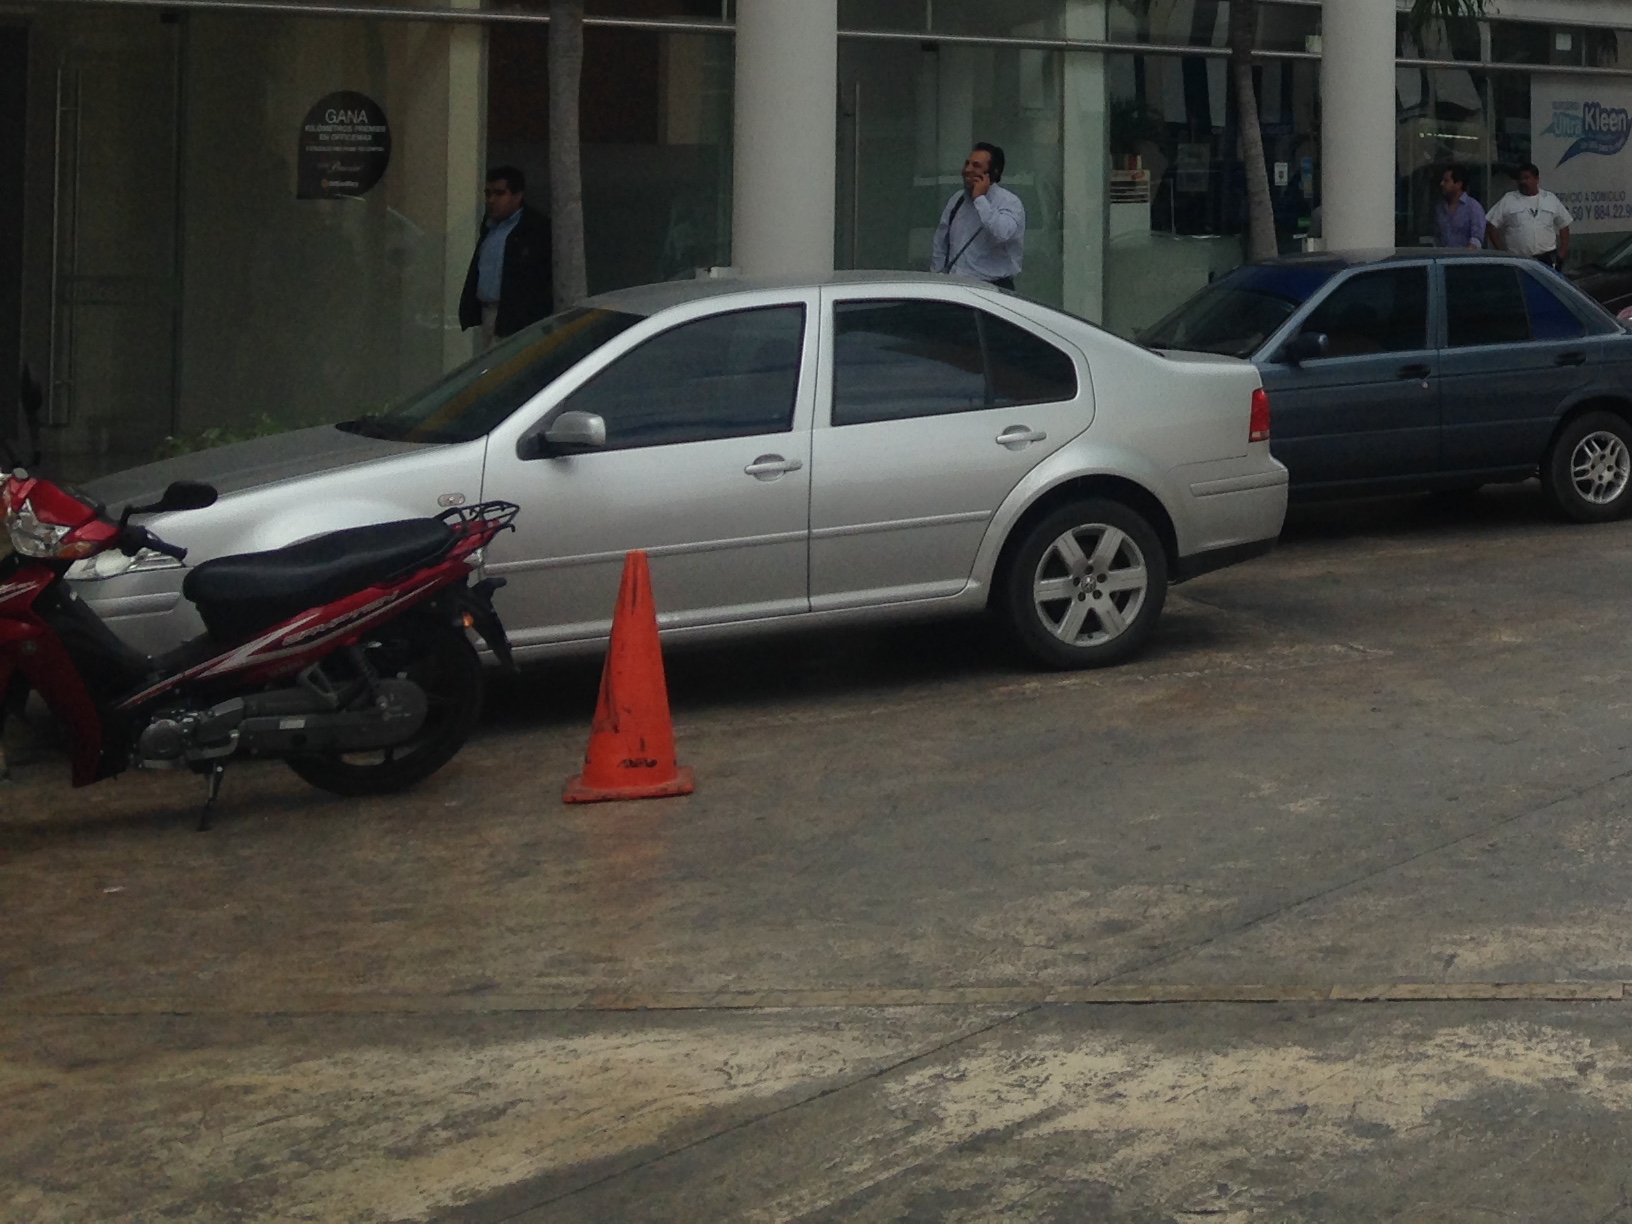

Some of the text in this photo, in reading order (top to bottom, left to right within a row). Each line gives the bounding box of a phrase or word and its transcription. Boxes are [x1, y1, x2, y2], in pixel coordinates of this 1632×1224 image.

[325, 108, 369, 124] GANA
[1584, 106, 1627, 133] Kleen
[1585, 205, 1592, 220] Y
